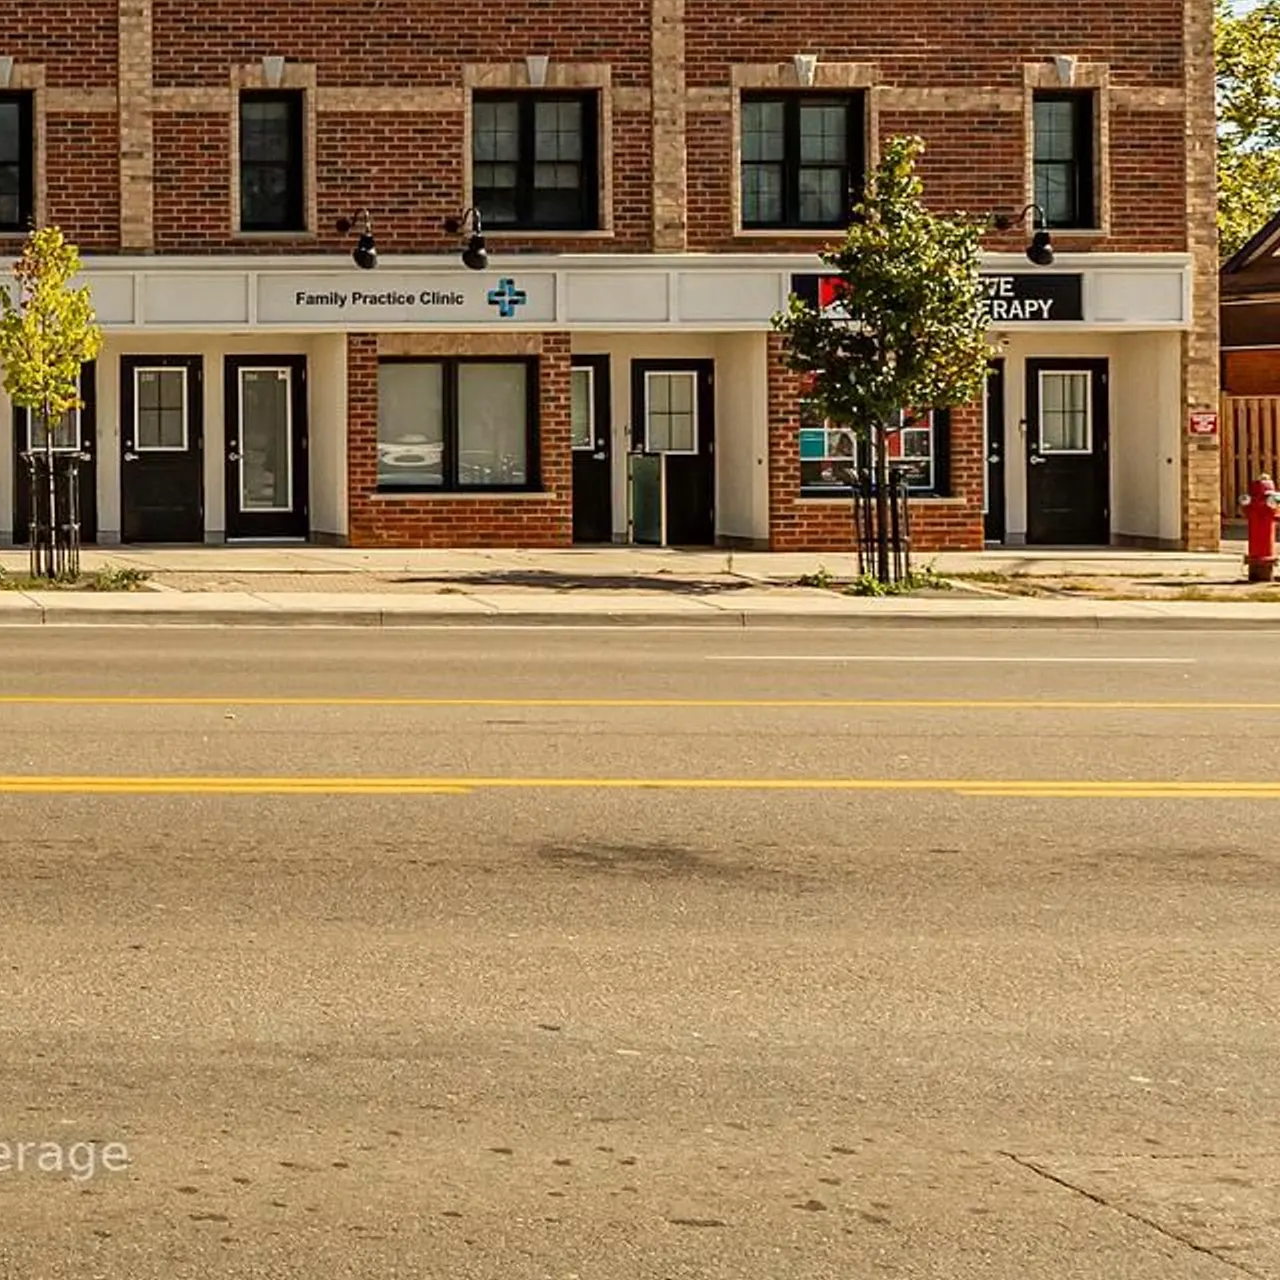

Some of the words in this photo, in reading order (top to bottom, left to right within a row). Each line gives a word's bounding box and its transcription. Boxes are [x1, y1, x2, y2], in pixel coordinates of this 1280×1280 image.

[296, 292, 347, 308] Family
[352, 292, 416, 305] Practice
[420, 291, 464, 305] Clinic
